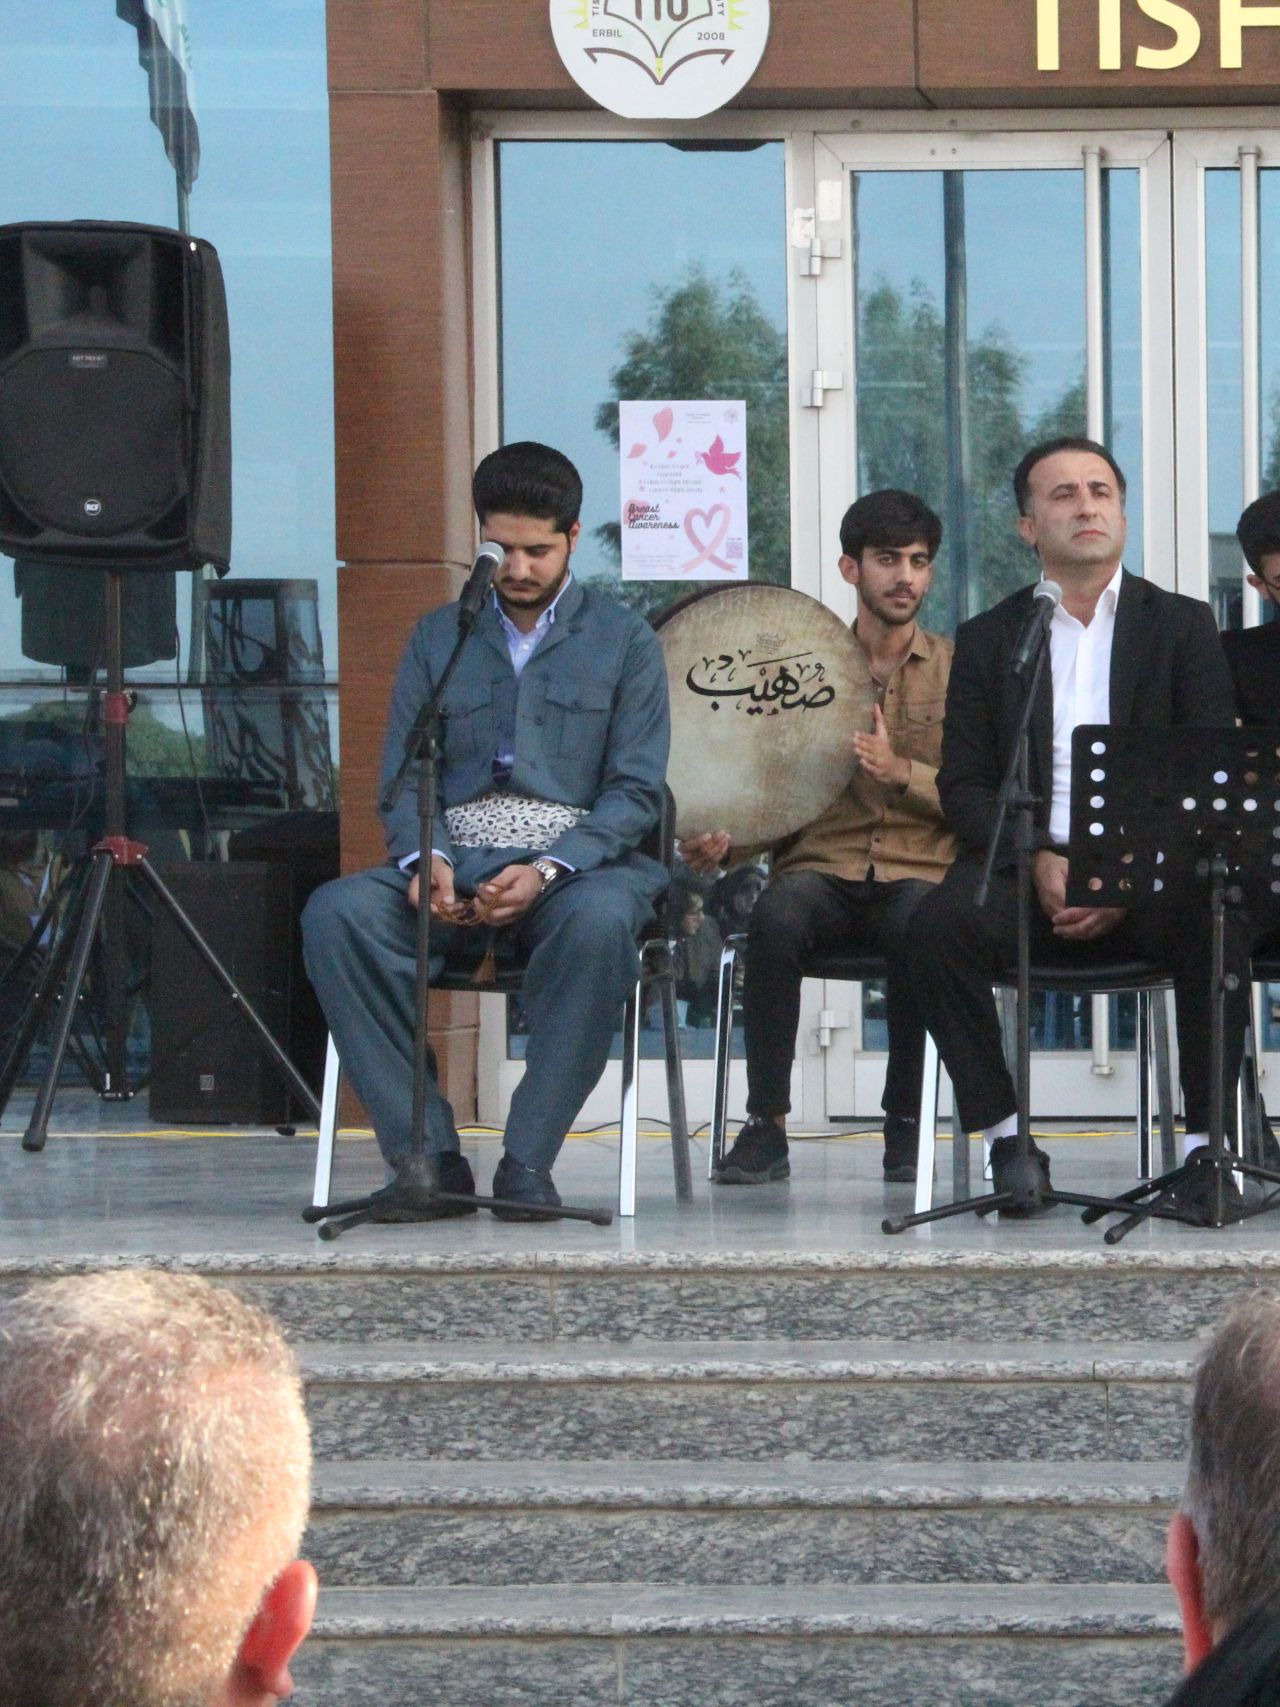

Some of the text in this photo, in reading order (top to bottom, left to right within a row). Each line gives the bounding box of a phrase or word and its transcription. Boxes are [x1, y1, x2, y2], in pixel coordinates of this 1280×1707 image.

[592, 29, 622, 38] ERBIL
[697, 32, 725, 41] 2008
[628, 503, 660, 513] Breast
[628, 512, 660, 521] Cancer
[628, 520, 680, 529] Awareness
